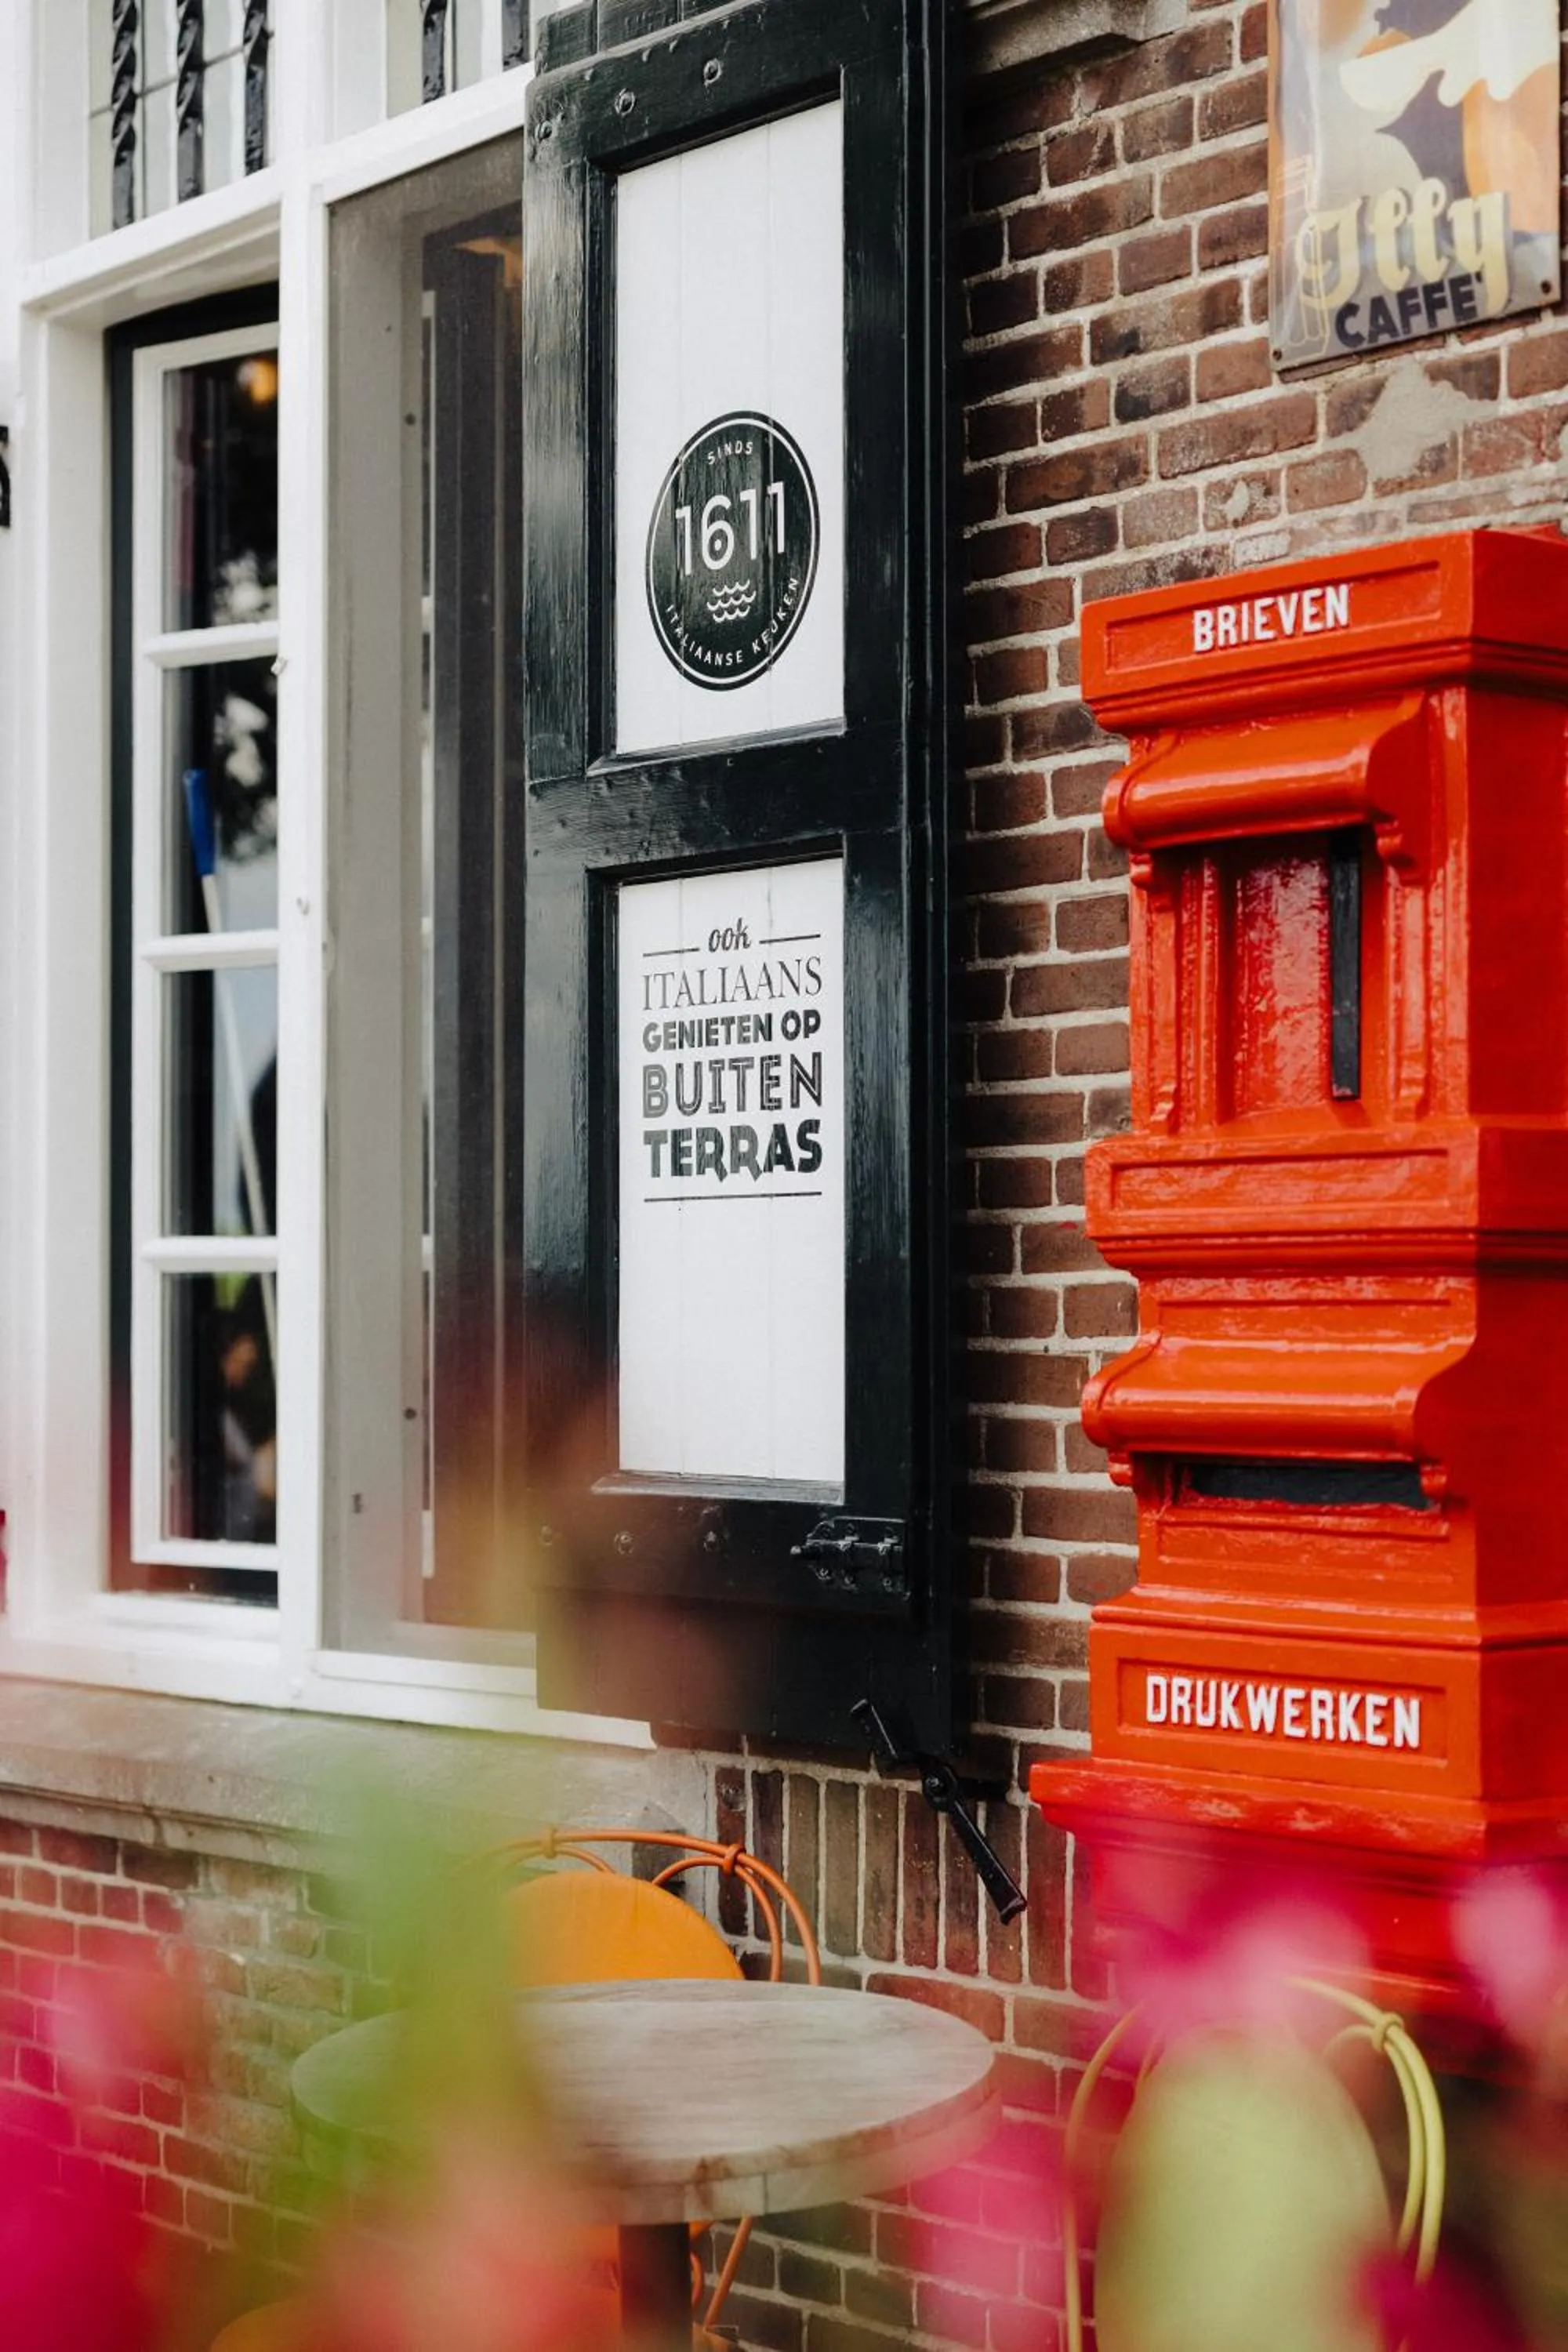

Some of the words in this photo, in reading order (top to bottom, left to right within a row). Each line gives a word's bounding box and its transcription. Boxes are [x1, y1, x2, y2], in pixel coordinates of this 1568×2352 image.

[707, 441, 753, 465] SINDS
[676, 481, 784, 576] 1611
[753, 577, 799, 653] KEUKEN
[1193, 583, 1348, 652] BRIEVEN
[708, 918, 751, 953] ook
[642, 956, 822, 1011] ITALIAANS
[642, 1013, 772, 1052] GENIETEN
[781, 1009, 821, 1041] OP
[642, 1051, 822, 1118] BUITEN
[643, 1119, 822, 1182] TERRAS
[1145, 1675, 1420, 1748] DRUKWERKEN
